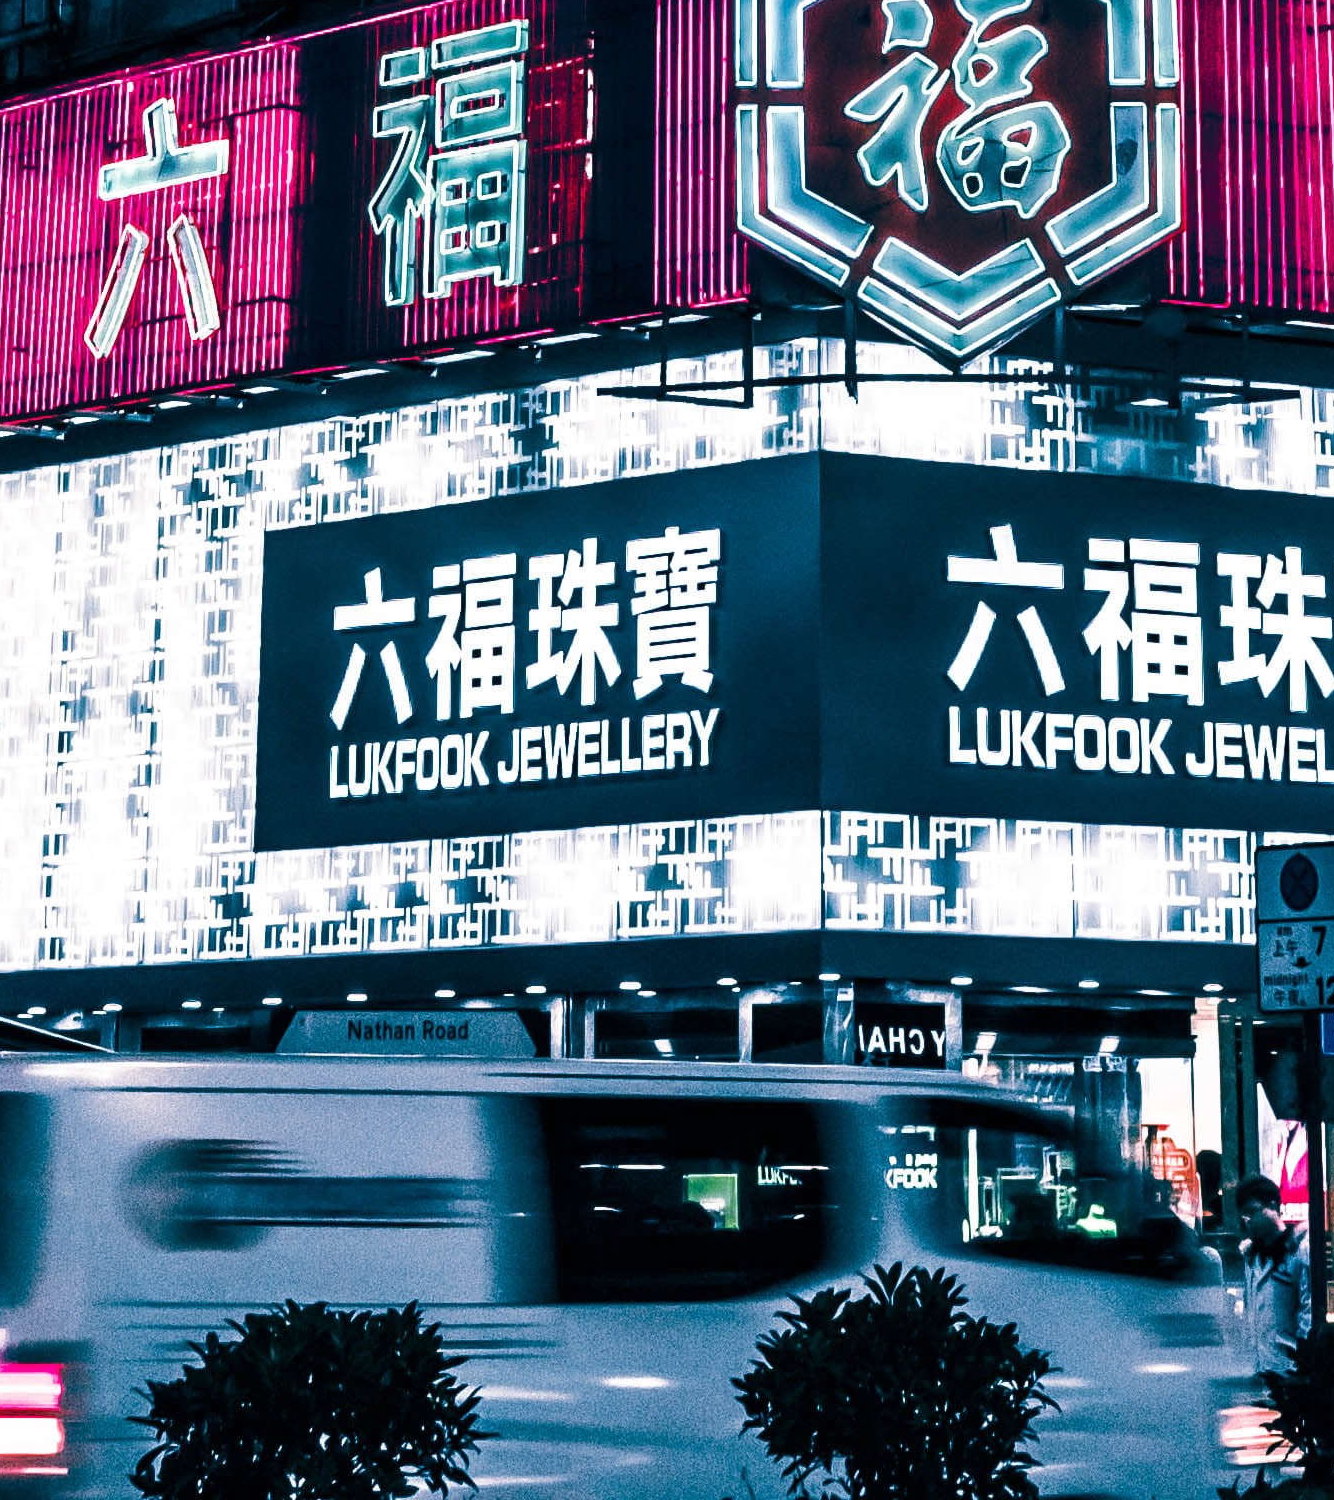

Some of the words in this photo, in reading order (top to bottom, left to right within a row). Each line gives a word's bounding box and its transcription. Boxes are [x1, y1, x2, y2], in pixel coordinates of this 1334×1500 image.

[83, 18, 530, 360] 六福
[329, 526, 722, 729] 六福珠寶
[328, 731, 488, 802] LUKFOOK
[497, 706, 721, 785] JEWELLERY
[947, 705, 1175, 777] LUKFOOK
[1312, 925, 1327, 957] 7
[347, 1020, 415, 1041] Nathan
[422, 1020, 469, 1041] Road
